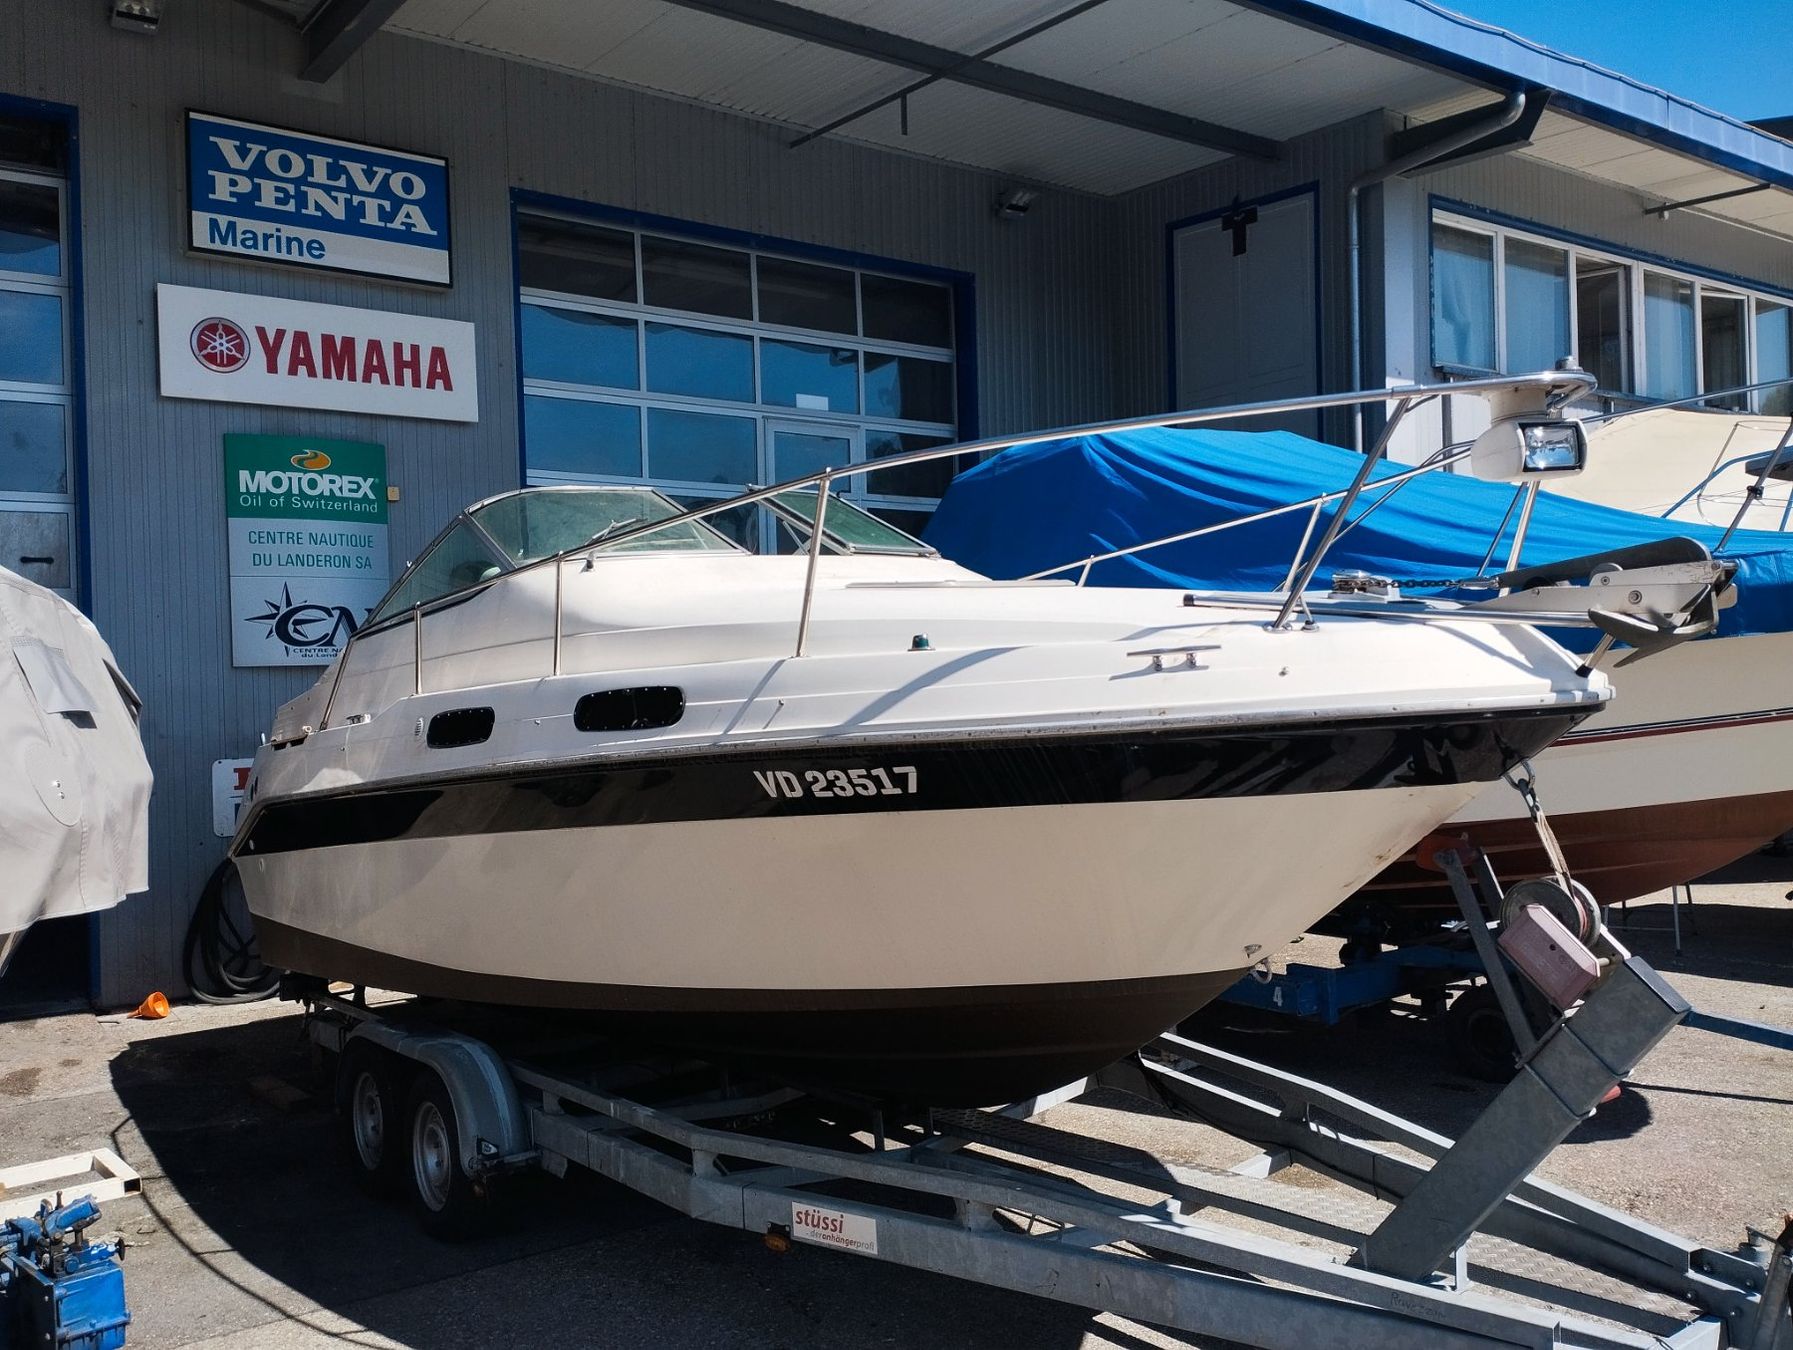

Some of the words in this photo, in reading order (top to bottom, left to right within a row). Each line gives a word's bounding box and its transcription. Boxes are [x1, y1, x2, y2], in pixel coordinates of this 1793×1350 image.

[208, 135, 427, 201] VOLVO
[207, 169, 438, 237] PENTA
[208, 217, 327, 261] Marine
[254, 325, 454, 393] YAMAHA
[238, 469, 377, 500] MOTOREX
[239, 494, 262, 507] Oil
[269, 495, 285, 508] of
[291, 496, 378, 513] Switzerland
[247, 530, 304, 546] CENTRE
[308, 531, 375, 549] NAUTIQUE
[252, 552, 273, 567] DU
[277, 553, 352, 569] LANDERON
[355, 555, 373, 570] SA
[752, 770, 804, 799] VD
[804, 765, 918, 798] 23517
[794, 1208, 845, 1235] stüssi
